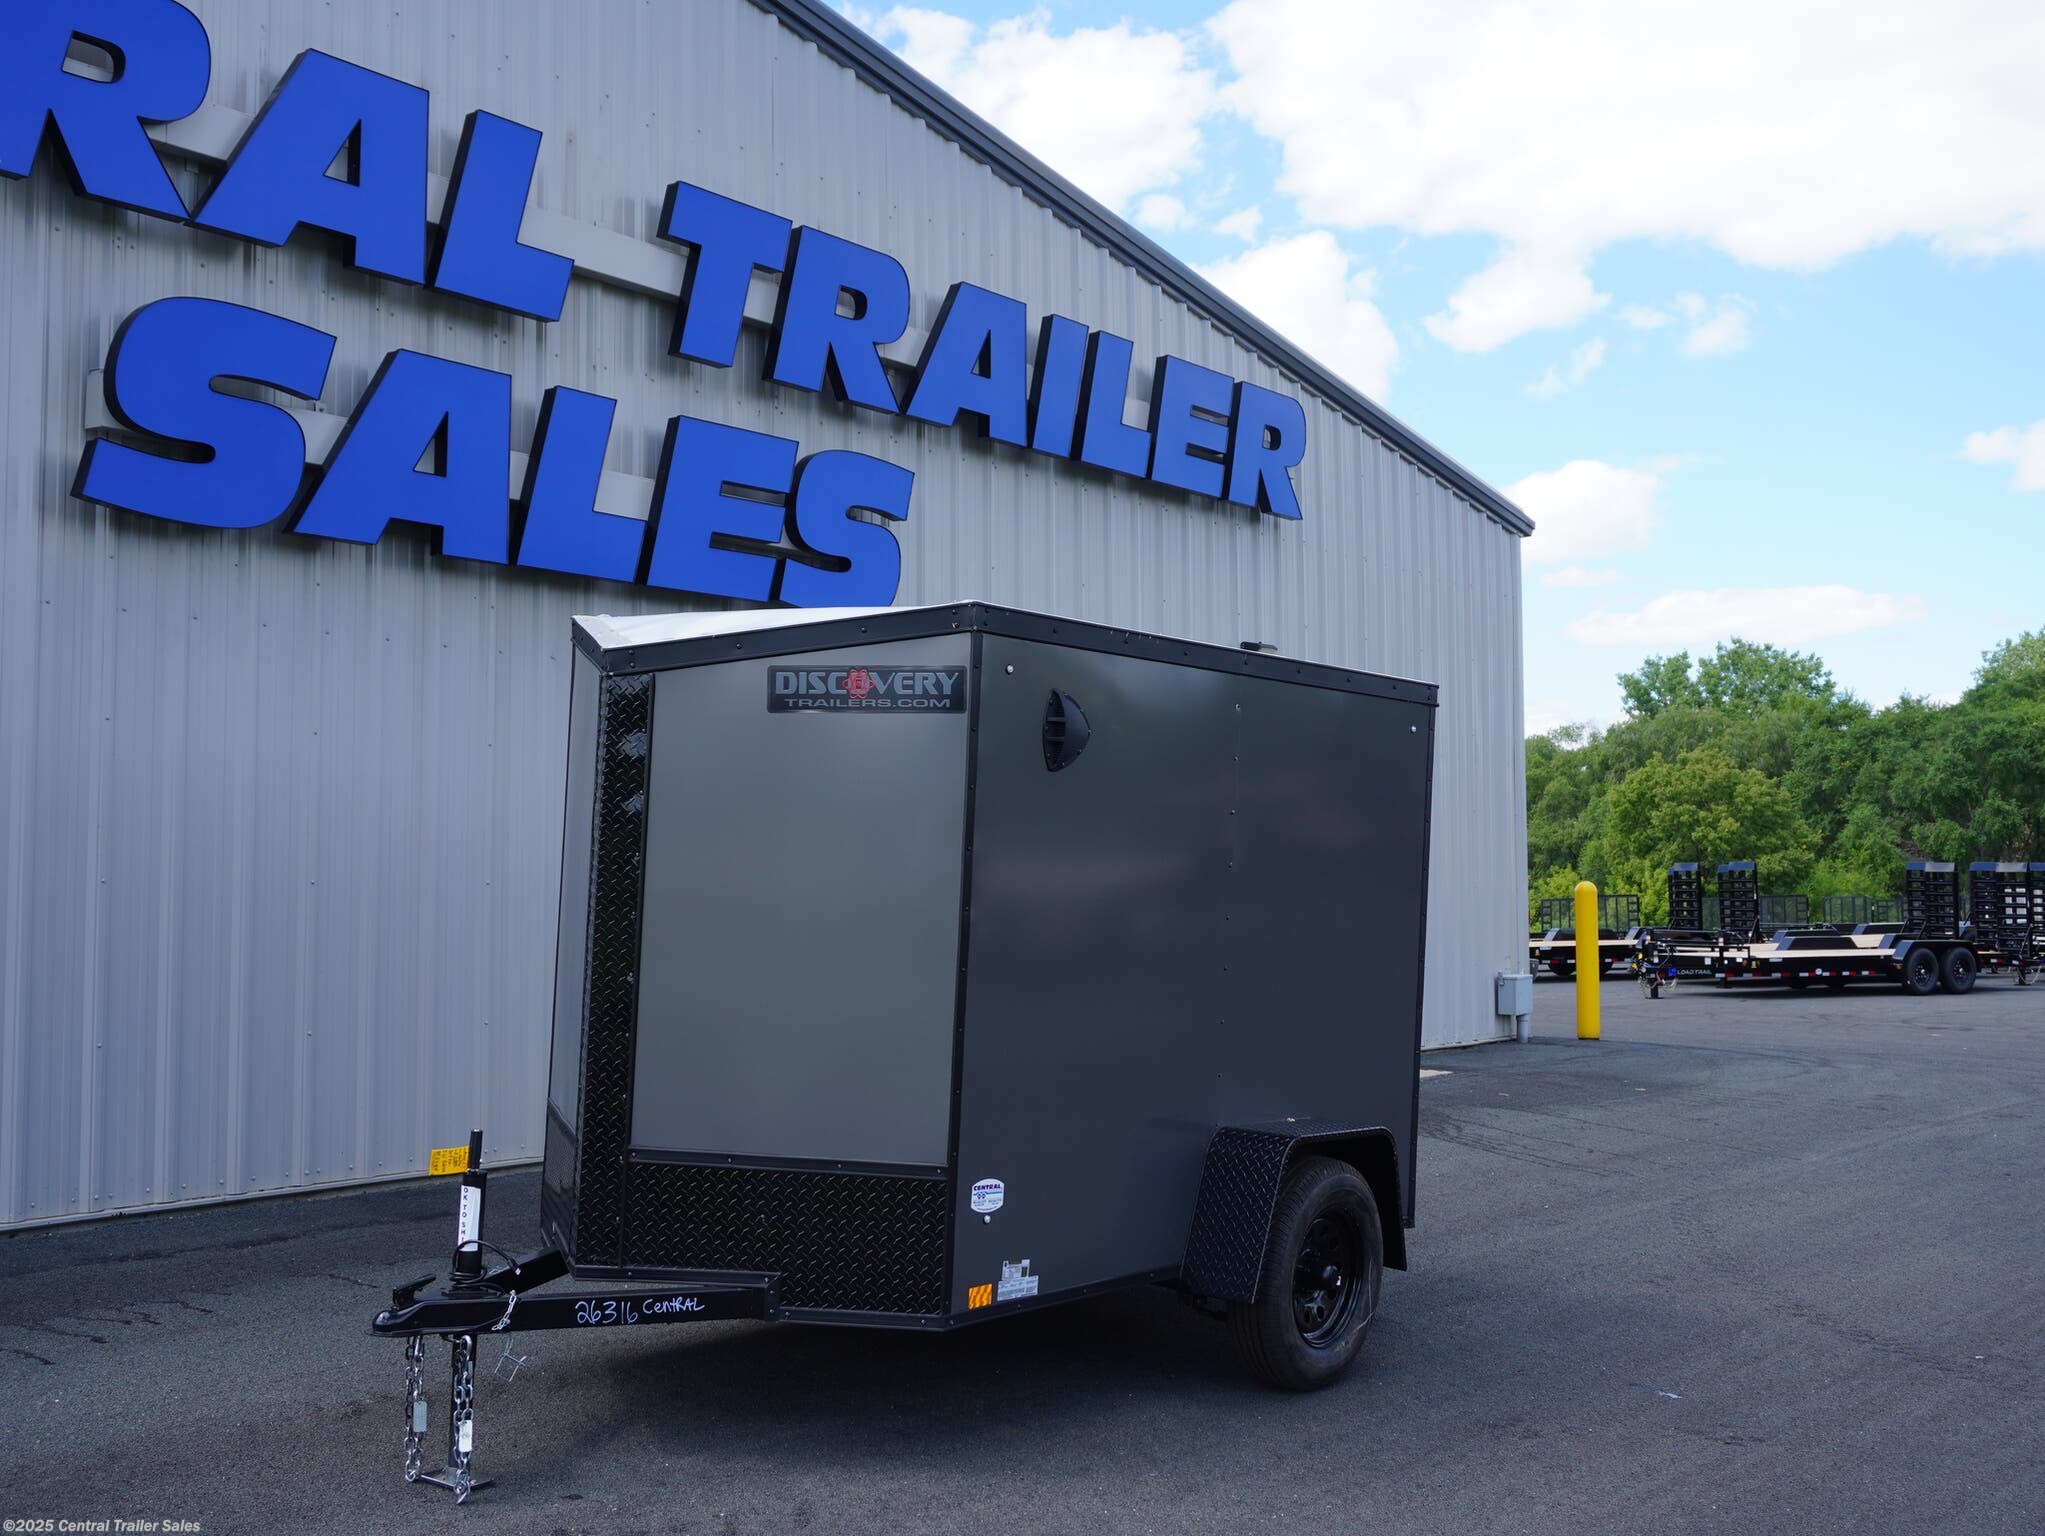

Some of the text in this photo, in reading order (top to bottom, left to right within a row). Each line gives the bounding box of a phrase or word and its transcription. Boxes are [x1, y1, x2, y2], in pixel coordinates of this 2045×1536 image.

[0, 0, 1306, 520] RAL TRAILER
[70, 296, 915, 607] SALES
[784, 698, 950, 708] TRAILERS.COM
[973, 1183, 1001, 1191] CENTRAL
[575, 1300, 638, 1325] 26316
